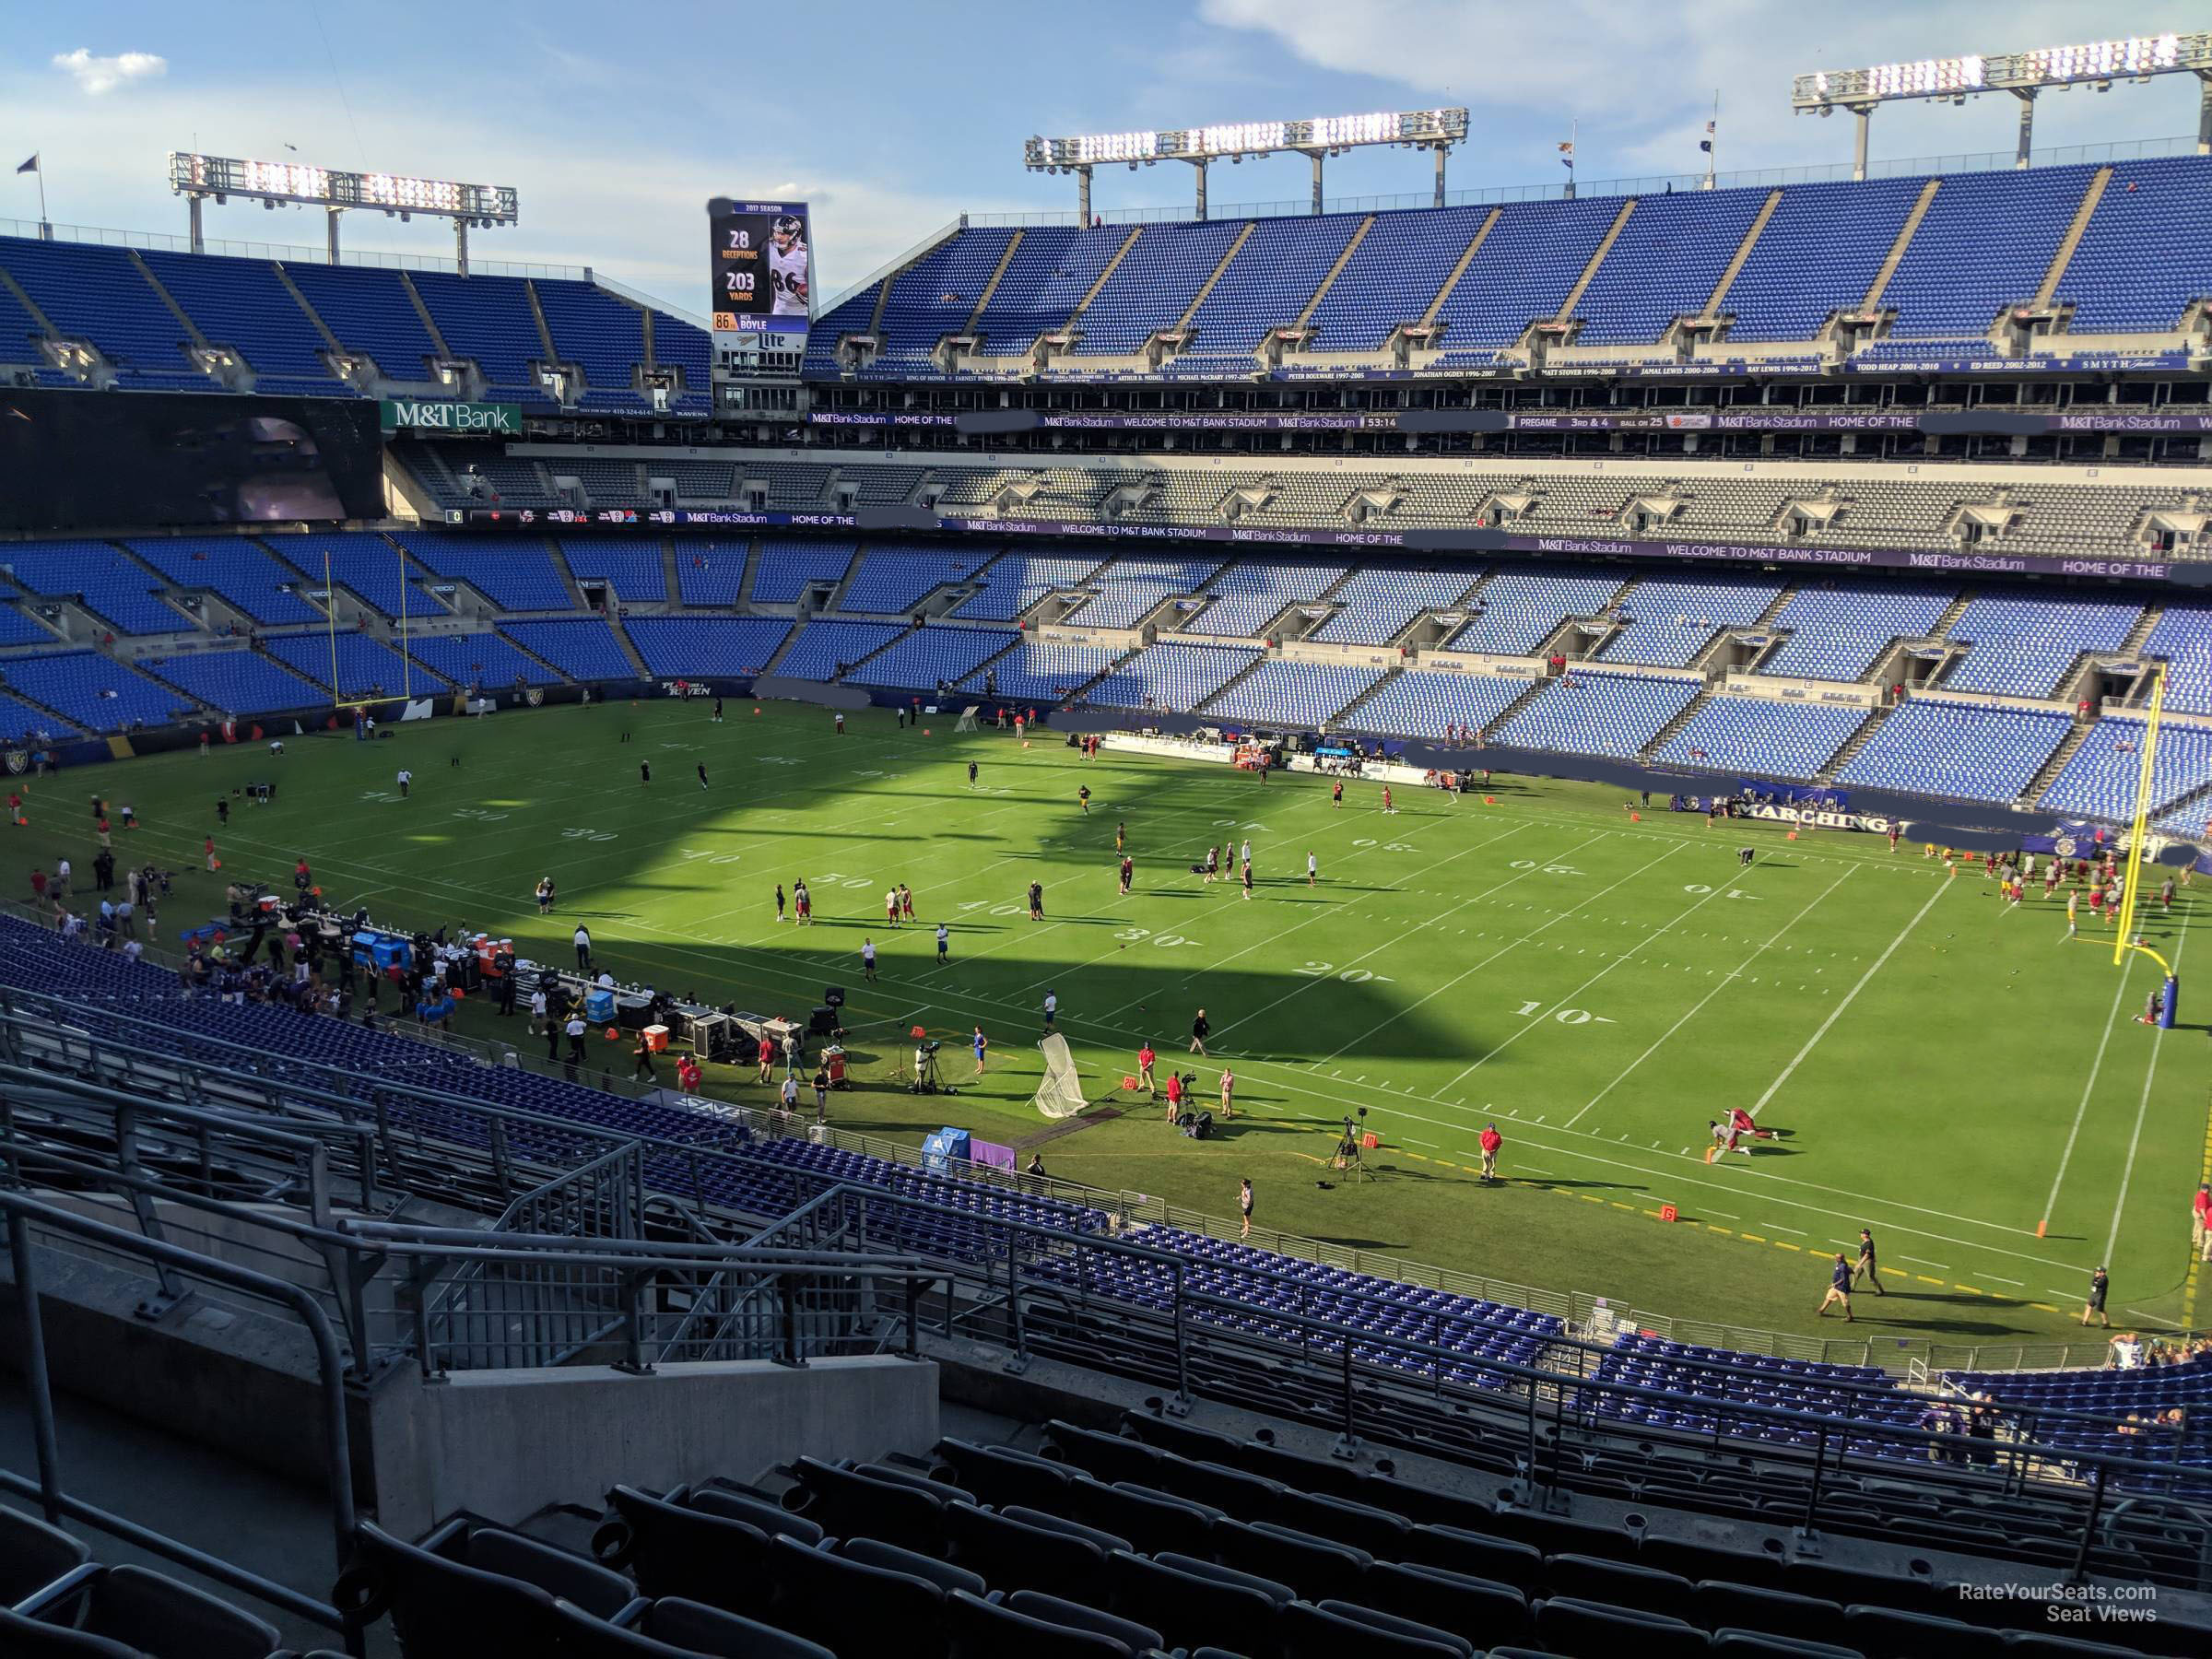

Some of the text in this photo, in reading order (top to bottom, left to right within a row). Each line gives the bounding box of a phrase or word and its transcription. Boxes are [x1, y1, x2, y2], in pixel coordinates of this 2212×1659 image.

[729, 230, 749, 249] 28
[723, 250, 758, 260] RECEPTIONS
[726, 273, 755, 290] 203
[729, 292, 753, 301] YARDS
[716, 314, 729, 328] 86
[741, 321, 767, 330] BOYLE
[758, 333, 784, 349] Lite
[2083, 360, 2129, 369] SMYTH
[394, 402, 509, 428] M&T Bank
[812, 413, 886, 424] M&T Bank Stadium
[894, 416, 921, 425] HOME
[922, 416, 935, 425] OF
[936, 416, 952, 425] THE
[1044, 417, 1113, 427] M&T Bank Stadium
[1124, 418, 1266, 428] WELCOME TO M&T BANK STADIUM
[1277, 418, 1355, 428] M&T Bank Stadium
[1368, 418, 1396, 427] 53:14
[1521, 418, 1557, 427] PREGAME
[1571, 418, 1608, 427] 3RD & 4
[1650, 418, 1663, 427] 25
[1718, 417, 1745, 428] M&T
[1746, 417, 1771, 428] Bank
[1773, 417, 1817, 428] Stadium
[1829, 417, 1865, 427] HOME
[1868, 417, 1887, 427] OF
[1889, 417, 1913, 427] THE
[2060, 416, 2180, 429] M&T Bank Stadium
[453, 512, 461, 522] 0
[687, 512, 767, 524] M&T Bank Stadium
[792, 515, 854, 525] HOME OF THE
[967, 520, 1036, 532] M&T Bank Stadium
[1062, 524, 1206, 537] WELCOME TO M&T BANK STADIUM
[1231, 529, 1311, 542] M&T Bank Stadium
[1336, 534, 1403, 545] HOME OF THE
[1538, 538, 1631, 553] M&T Bank Stadium
[1666, 545, 1871, 563] WELCOME TO M&T BANK STADIUM
[1909, 554, 2025, 570] M&T Bank Stadium
[2063, 560, 2164, 577] HOME OF THE
[669, 688, 711, 696] RVEN
[1738, 803, 1888, 832] MARCHING
[560, 828, 618, 841] 30
[680, 848, 740, 864] 40
[809, 873, 874, 888] 50
[957, 900, 1020, 916] 40
[1113, 928, 1183, 947] 30
[1292, 961, 1373, 982] 20
[1510, 1000, 1592, 1024] 10
